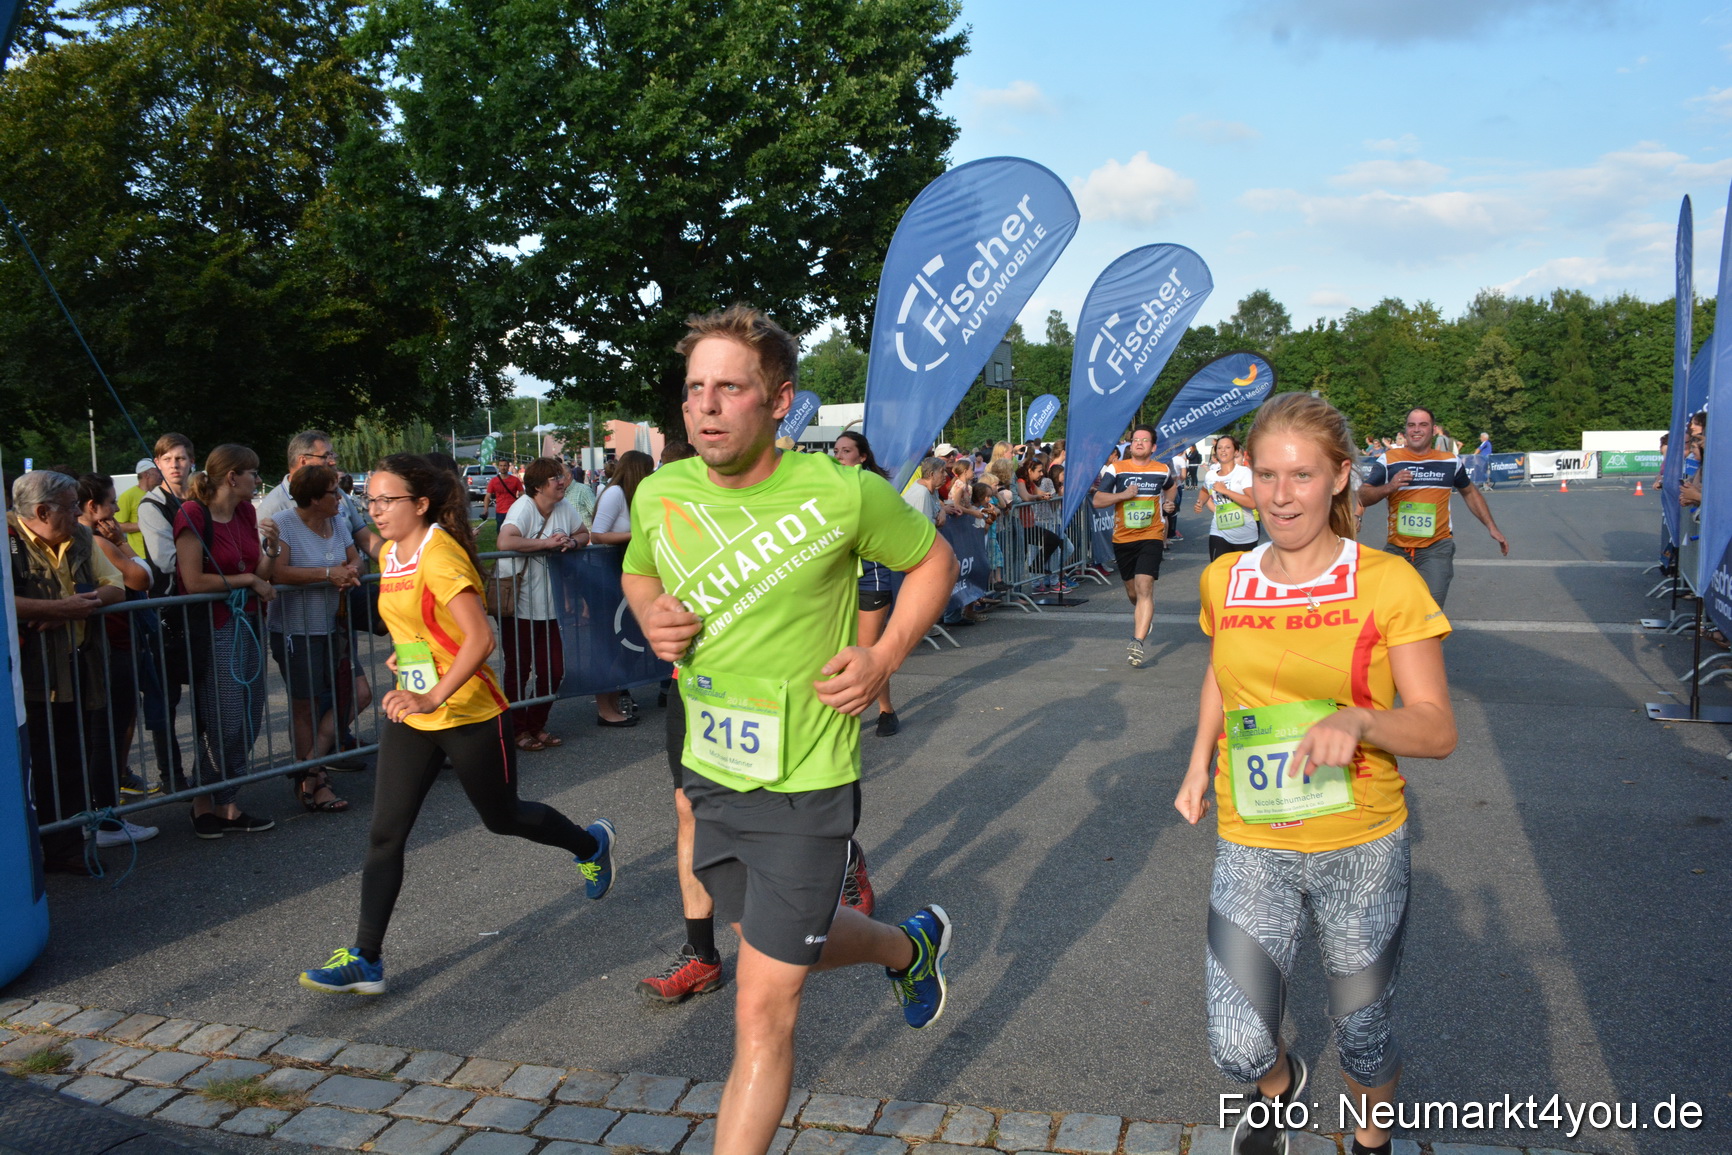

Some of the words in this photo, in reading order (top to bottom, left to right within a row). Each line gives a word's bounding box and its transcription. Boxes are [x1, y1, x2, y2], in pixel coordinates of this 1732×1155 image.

[923, 194, 1034, 346] Fischer
[961, 223, 1047, 345] AUTOMOBILE
[1106, 267, 1182, 376] Fischer
[1133, 287, 1191, 375] AUTOMOBILE
[784, 398, 811, 434] Fischer
[1033, 400, 1053, 430] Fischer
[1159, 387, 1242, 439] Frischmann
[1212, 403, 1233, 417] Druck
[1245, 382, 1270, 400] Medien
[1606, 454, 1628, 466] AOK
[1127, 511, 1152, 521] 1625
[1218, 511, 1241, 524] 1170
[1401, 514, 1432, 528] 1635
[708, 611, 734, 637] UND
[732, 525, 846, 616] GEBÄUDETECHNIK
[1219, 614, 1277, 631] MAX
[1285, 608, 1359, 631] BÖGL
[700, 710, 760, 754] 215
[1254, 799, 1275, 807] Nicole
[1275, 791, 1324, 806] Schumacher
